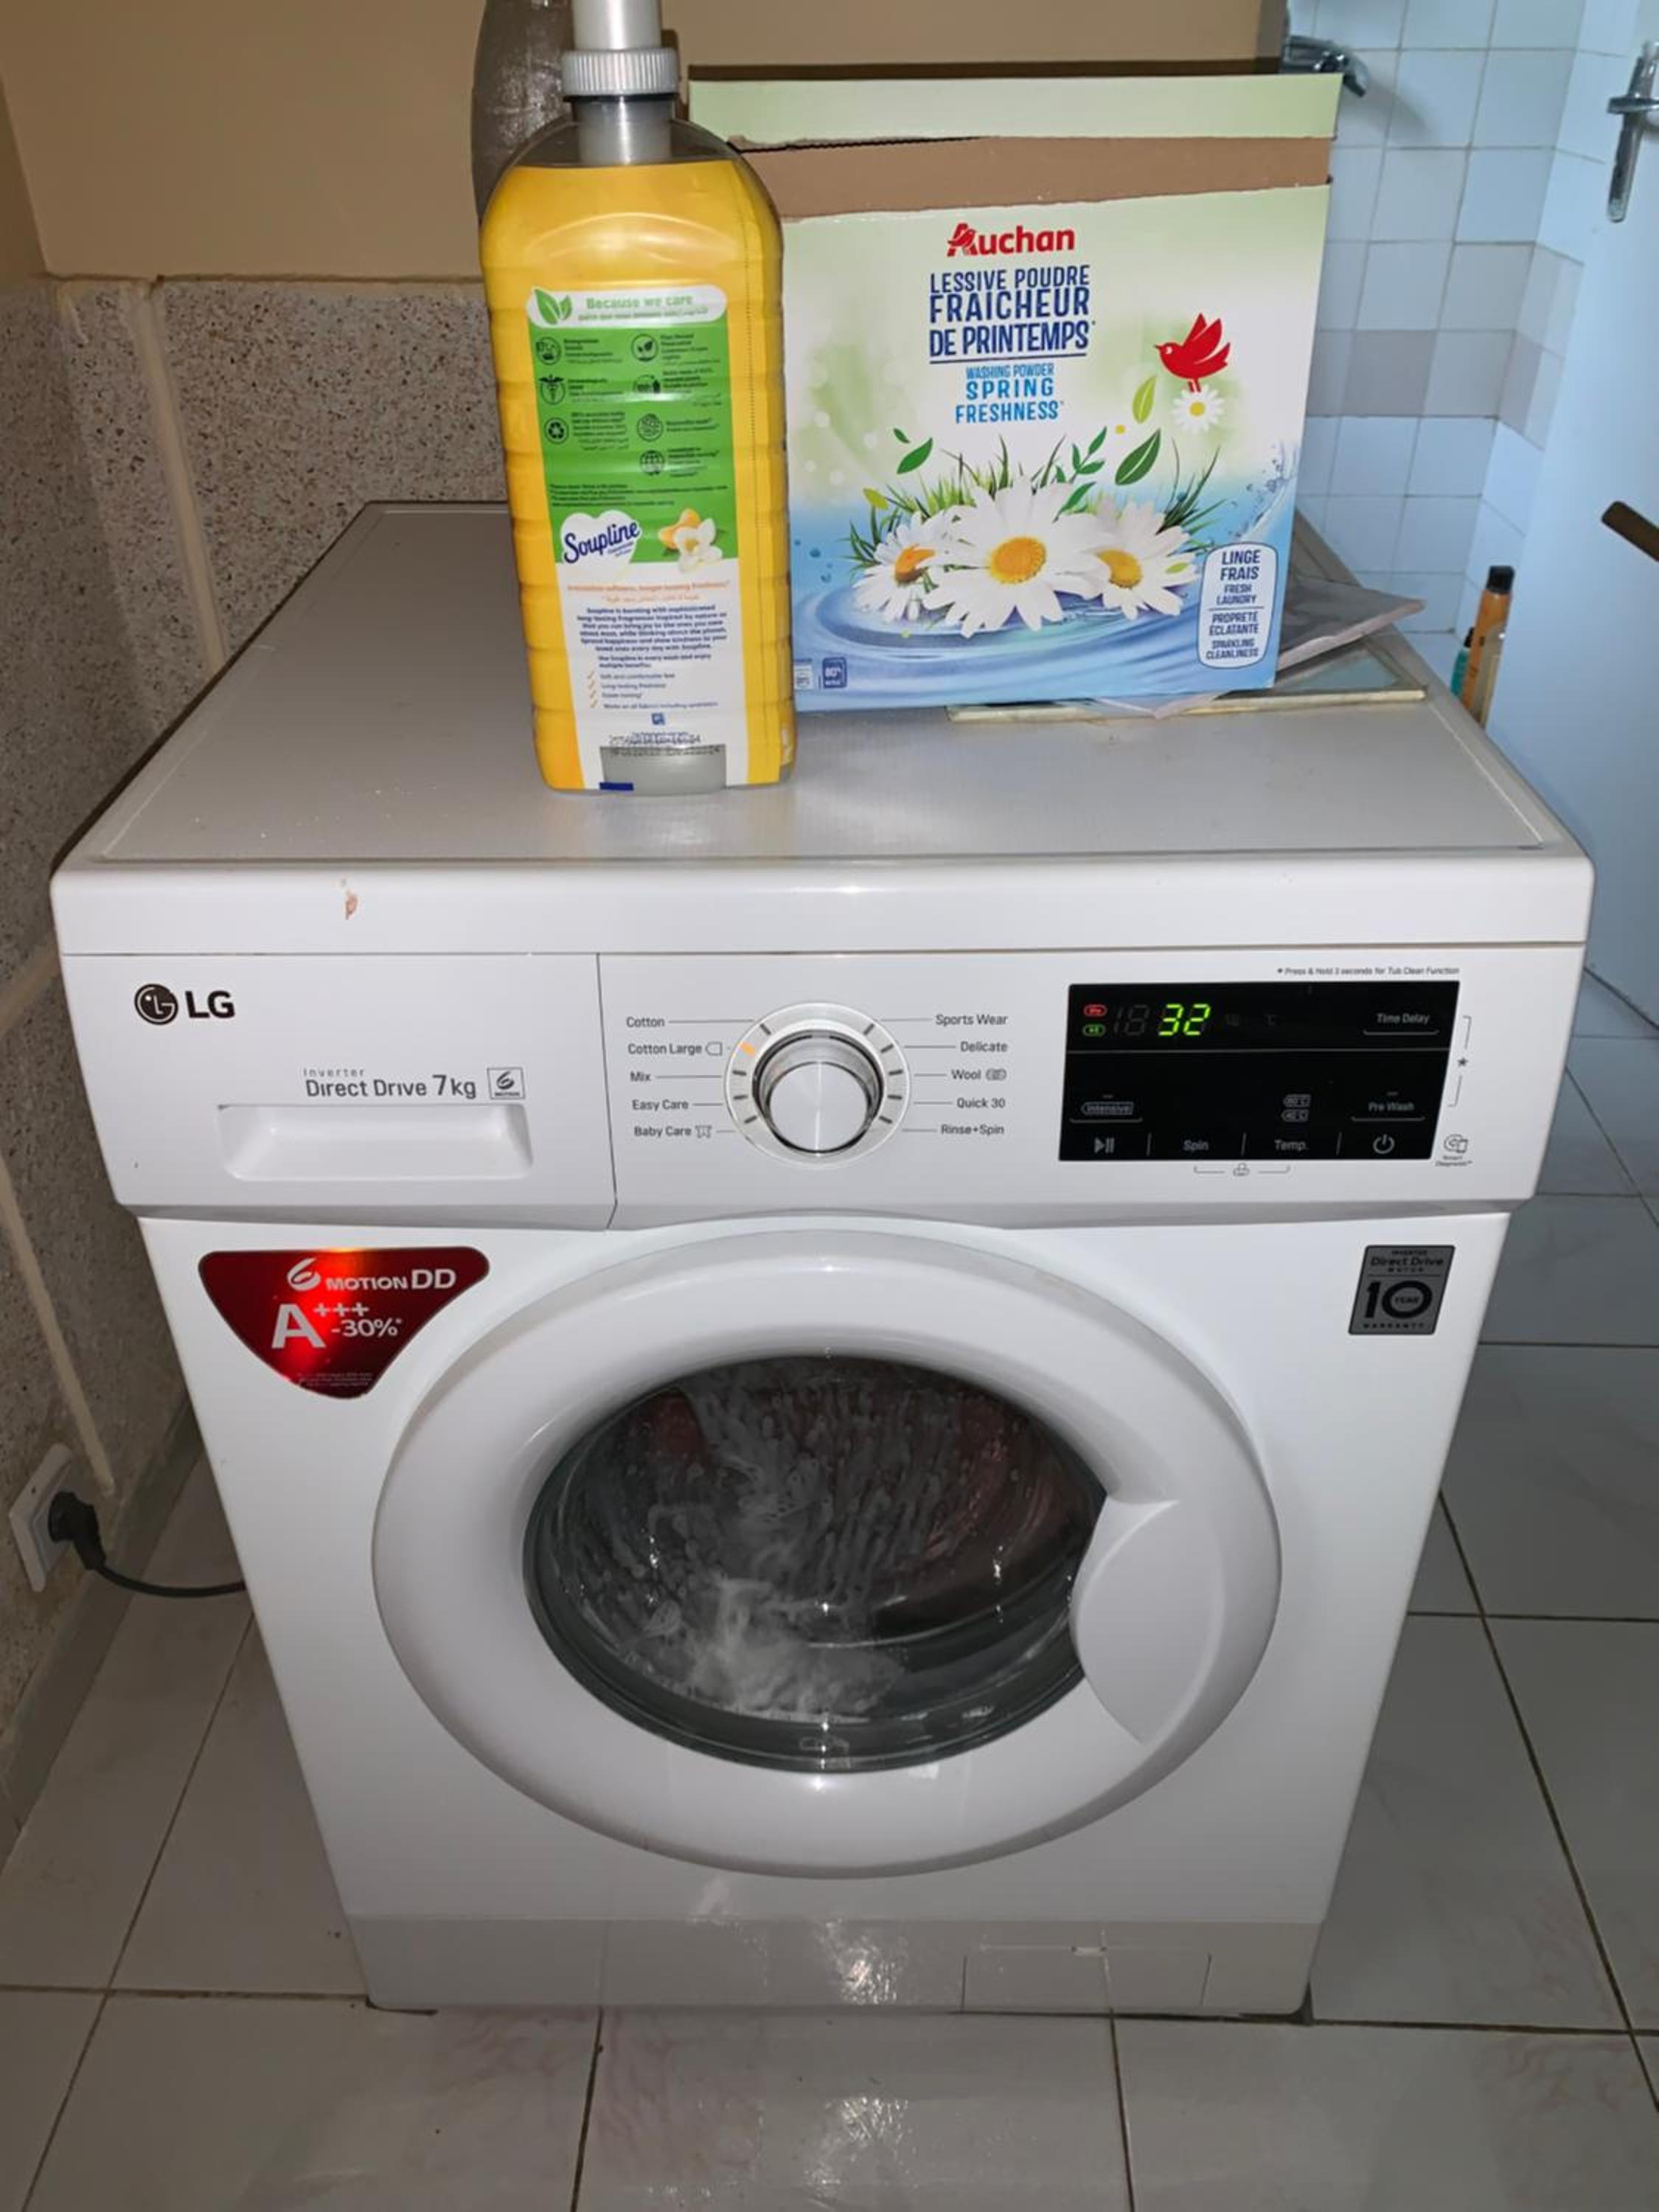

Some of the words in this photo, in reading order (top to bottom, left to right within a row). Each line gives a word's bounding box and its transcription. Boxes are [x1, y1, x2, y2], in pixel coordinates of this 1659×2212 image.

[947, 222, 1074, 257] Auchan
[931, 269, 1006, 293] LESSIVE
[1015, 265, 1090, 288] POUDRE
[586, 297, 639, 310] Because
[644, 296, 661, 307] we
[665, 295, 693, 306] care
[930, 287, 1090, 324] FRAICHEUR
[929, 329, 956, 357] DE
[966, 364, 1011, 380] WASHING
[1013, 362, 1054, 378] POWDER
[966, 377, 1054, 400] SPRING
[563, 521, 640, 564] Soupline
[1222, 550, 1260, 565] LINGE
[1220, 566, 1259, 581] FRAIS
[1225, 583, 1252, 594] FRESH
[1217, 595, 1256, 605] LAUNDRY
[1284, 967, 1306, 975] Press
[1315, 967, 1333, 975] Hold
[1341, 967, 1373, 975] seconds
[1403, 967, 1424, 975] Clean
[185, 990, 236, 1019] LG
[626, 1016, 665, 1029] Cotton
[935, 1013, 975, 1028] Sports
[977, 1013, 1009, 1026] Wear
[1158, 1003, 1211, 1036] 32
[1377, 1013, 1400, 1024] Time
[1402, 1012, 1430, 1025] Delay
[627, 1043, 667, 1055] Cotton
[669, 1043, 702, 1058] Large
[960, 1040, 1009, 1054] Delicate
[302, 1067, 366, 1078] Inverter
[630, 1071, 652, 1083] Mix
[951, 1068, 981, 1080] Wool
[305, 1078, 369, 1099] Direct
[373, 1078, 428, 1097] Drive
[633, 1099, 660, 1113] Easy
[662, 1099, 689, 1110] Care
[956, 1096, 988, 1110] Quick
[991, 1097, 1006, 1109] 30
[1369, 1102, 1385, 1112] Pre
[1387, 1102, 1414, 1112] Wash
[634, 1126, 663, 1140] Baby
[664, 1126, 692, 1137] Care
[1183, 1139, 1209, 1152] Spin
[1275, 1139, 1310, 1152] Temp.
[1370, 1256, 1408, 1266] Direct
[1411, 1256, 1443, 1265] Drive
[325, 1276, 408, 1290] MOTION
[411, 1269, 456, 1290] DD
[1364, 1279, 1433, 1320] 10
